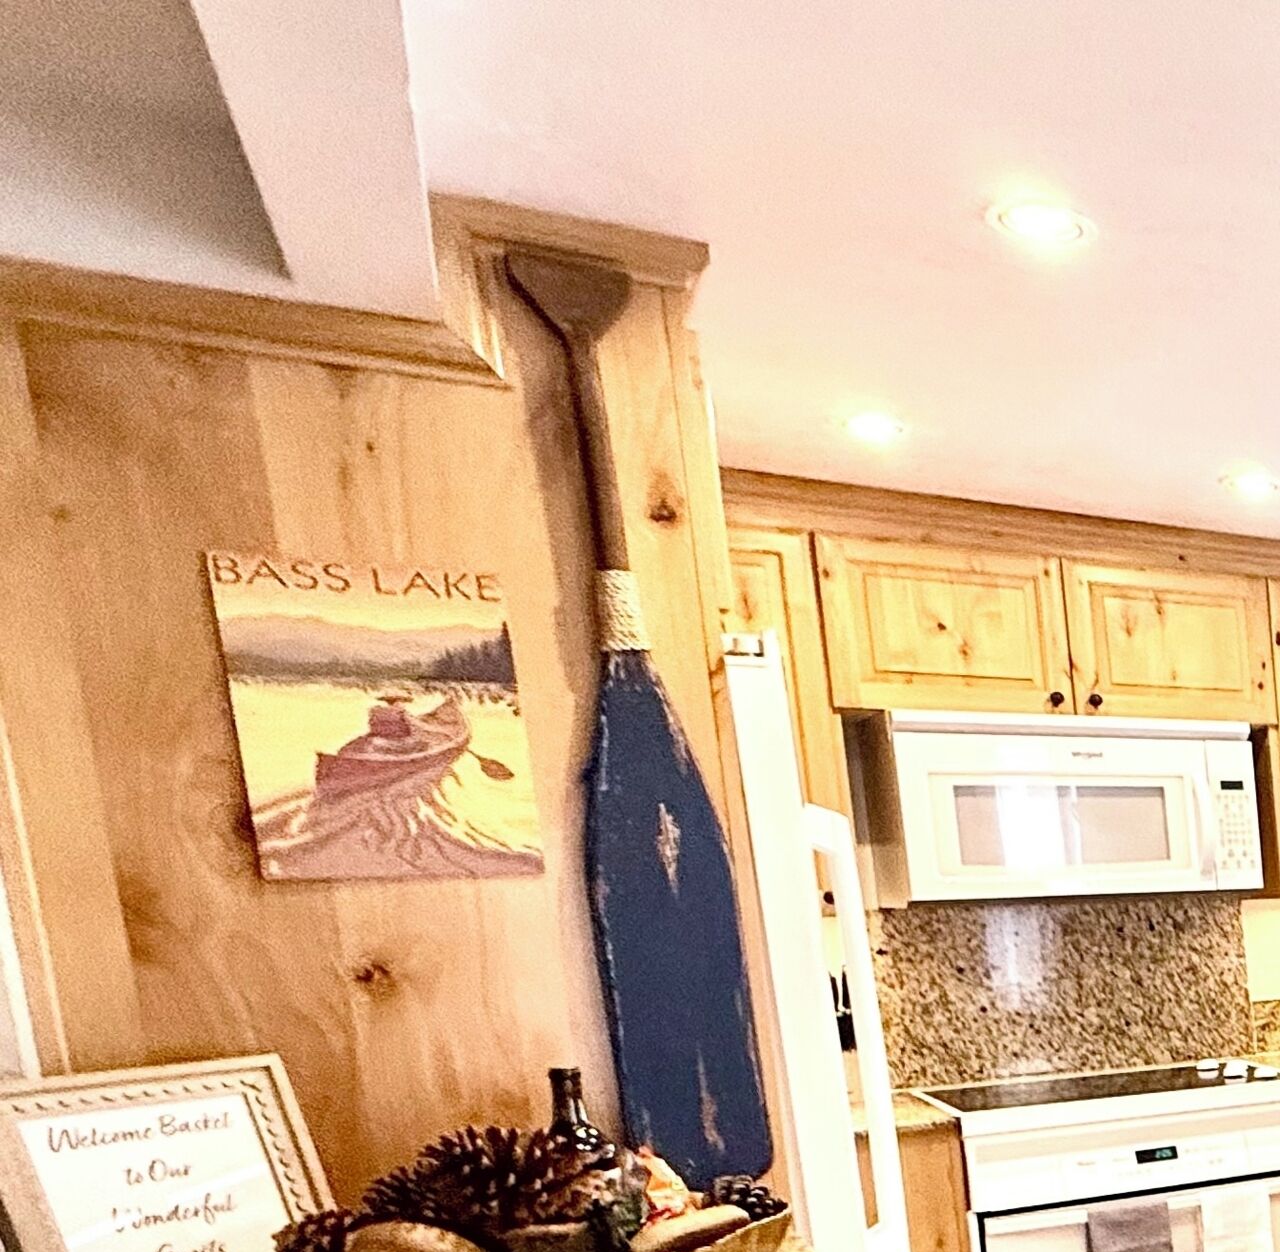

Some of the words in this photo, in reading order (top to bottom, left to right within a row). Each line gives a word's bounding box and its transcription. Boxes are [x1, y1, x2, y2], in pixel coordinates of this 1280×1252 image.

[211, 553, 351, 593] BASS
[371, 566, 502, 602] LAKE
[48, 1126, 152, 1153] Welcome
[124, 1167, 144, 1186] to
[149, 1158, 191, 1182] Our
